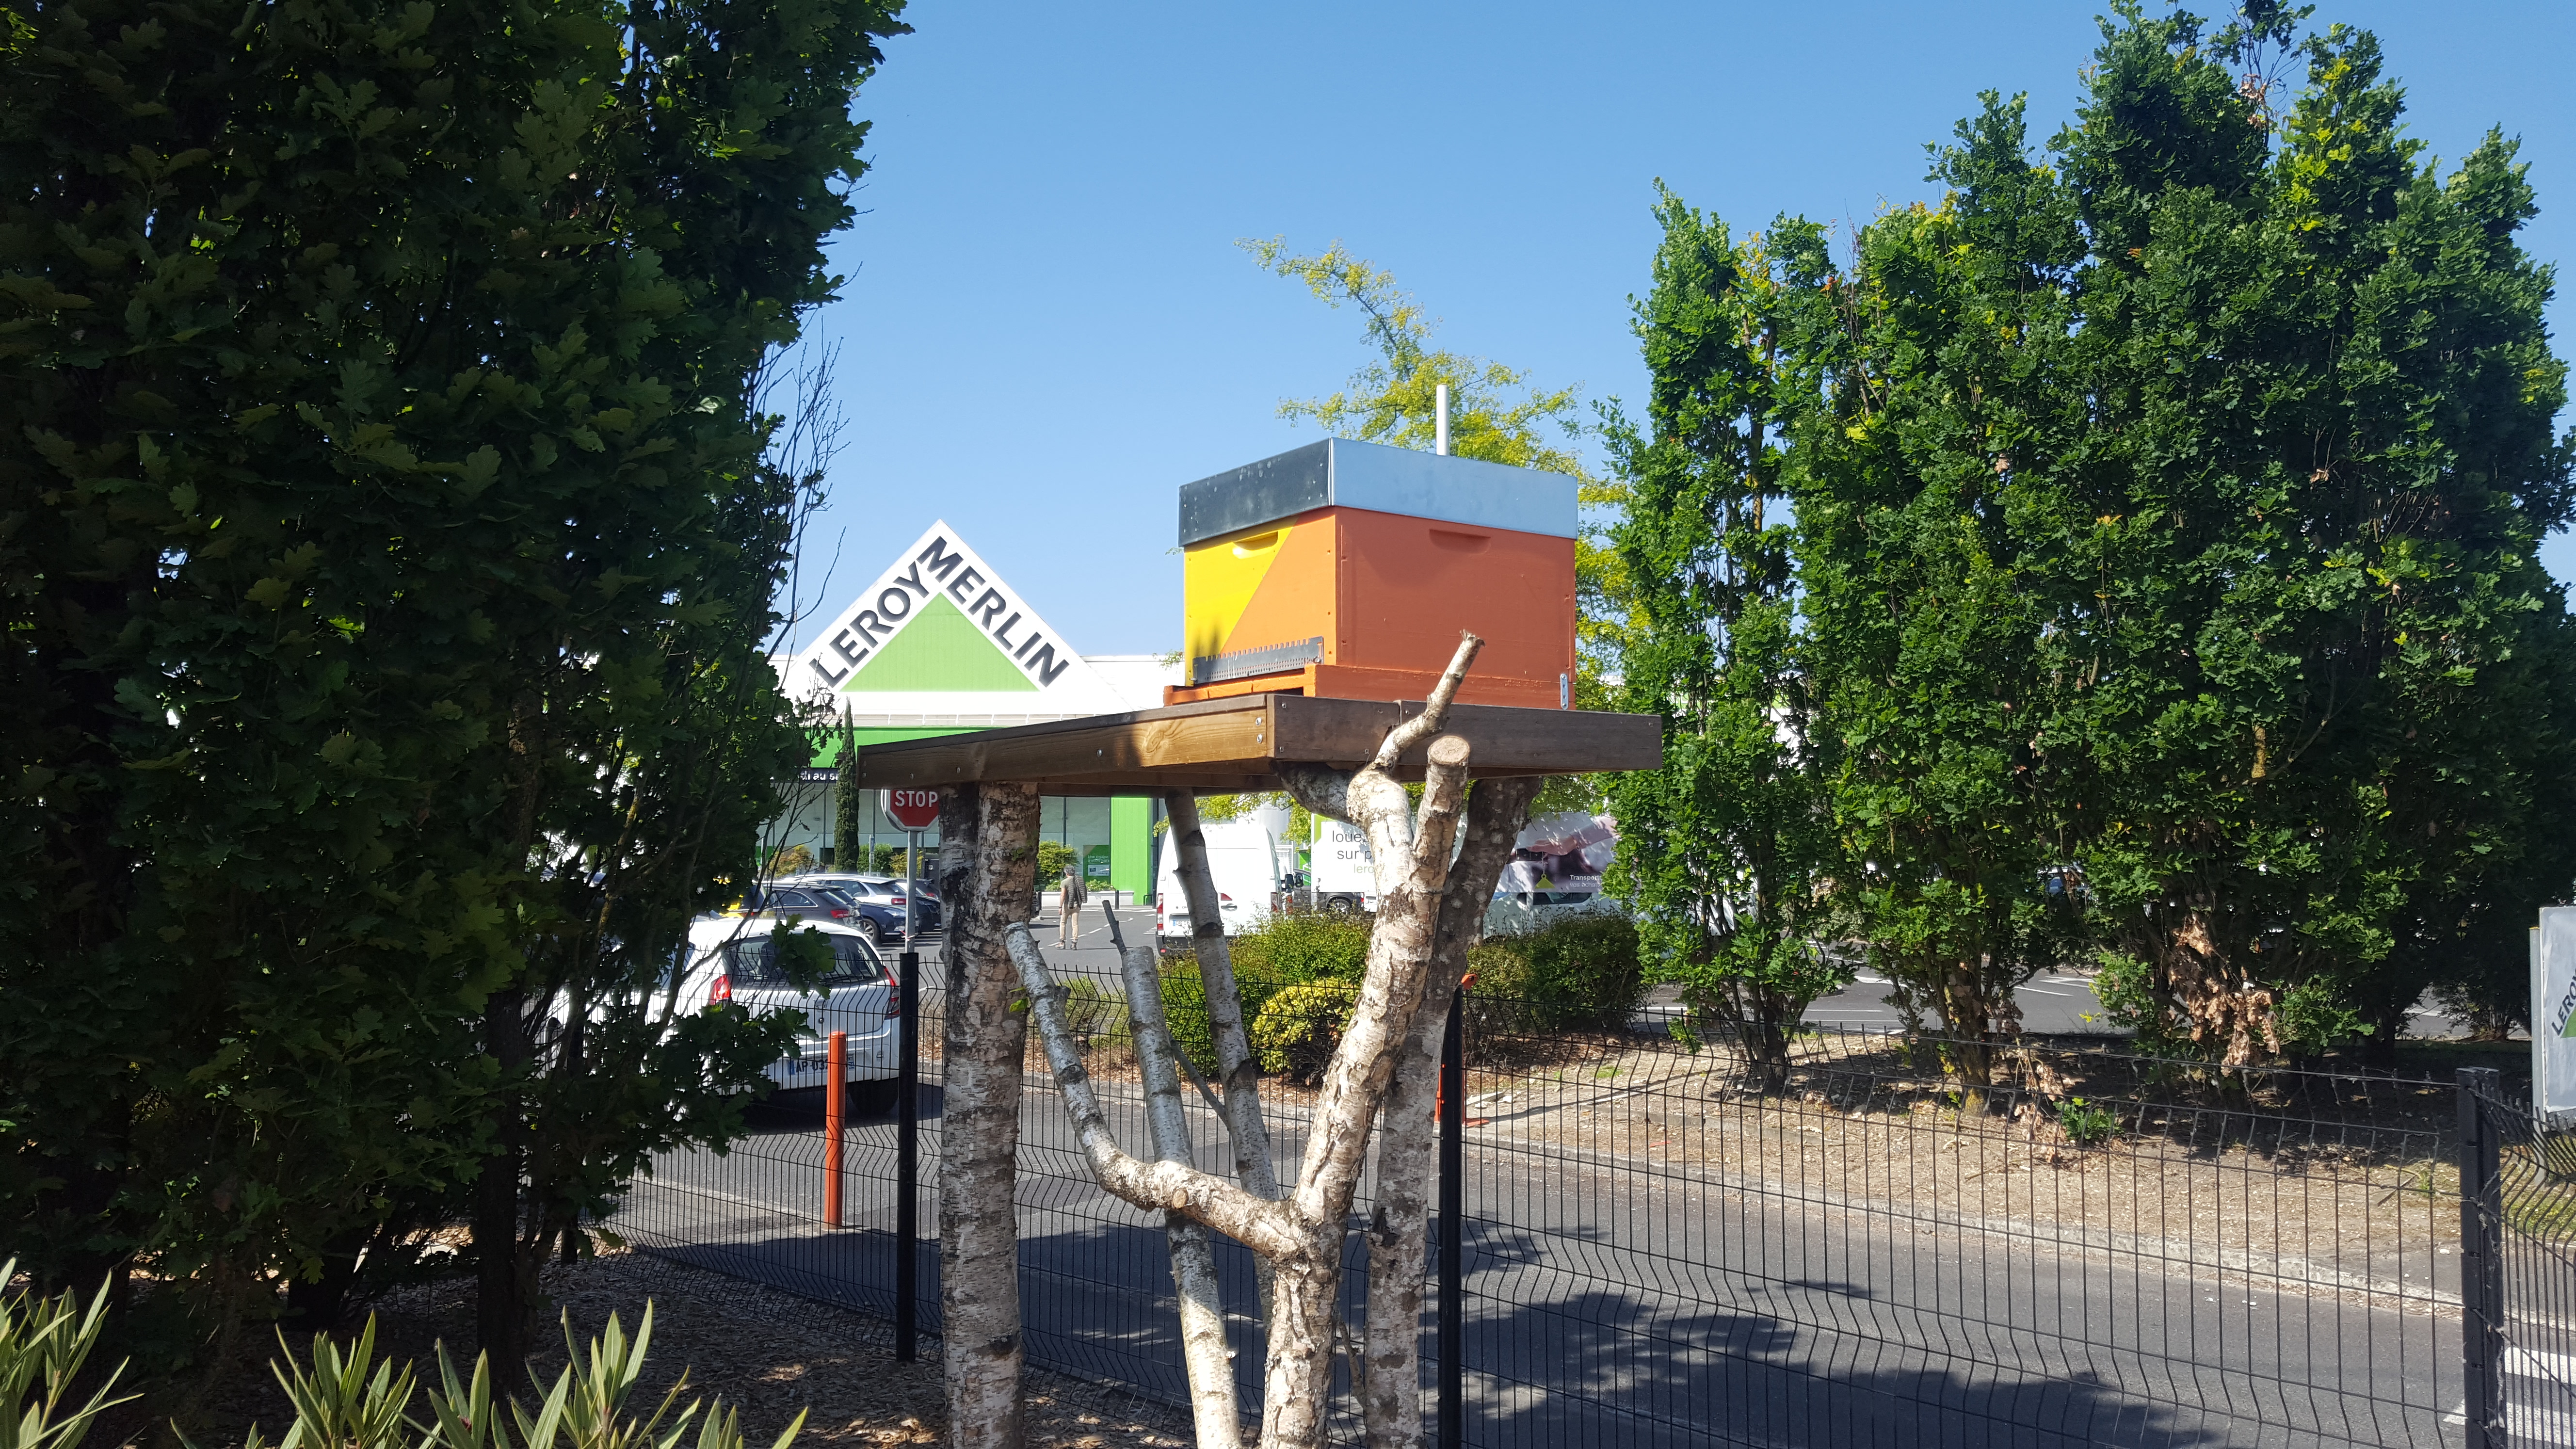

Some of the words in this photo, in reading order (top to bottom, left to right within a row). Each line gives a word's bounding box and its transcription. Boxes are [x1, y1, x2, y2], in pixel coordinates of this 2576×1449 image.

[808, 561, 929, 688] LEROY
[916, 535, 1070, 688] MERLIN
[895, 790, 938, 807] STOP
[1337, 851, 1359, 860] sur
[1365, 851, 1372, 863] p
[1353, 864, 1375, 873] lero
